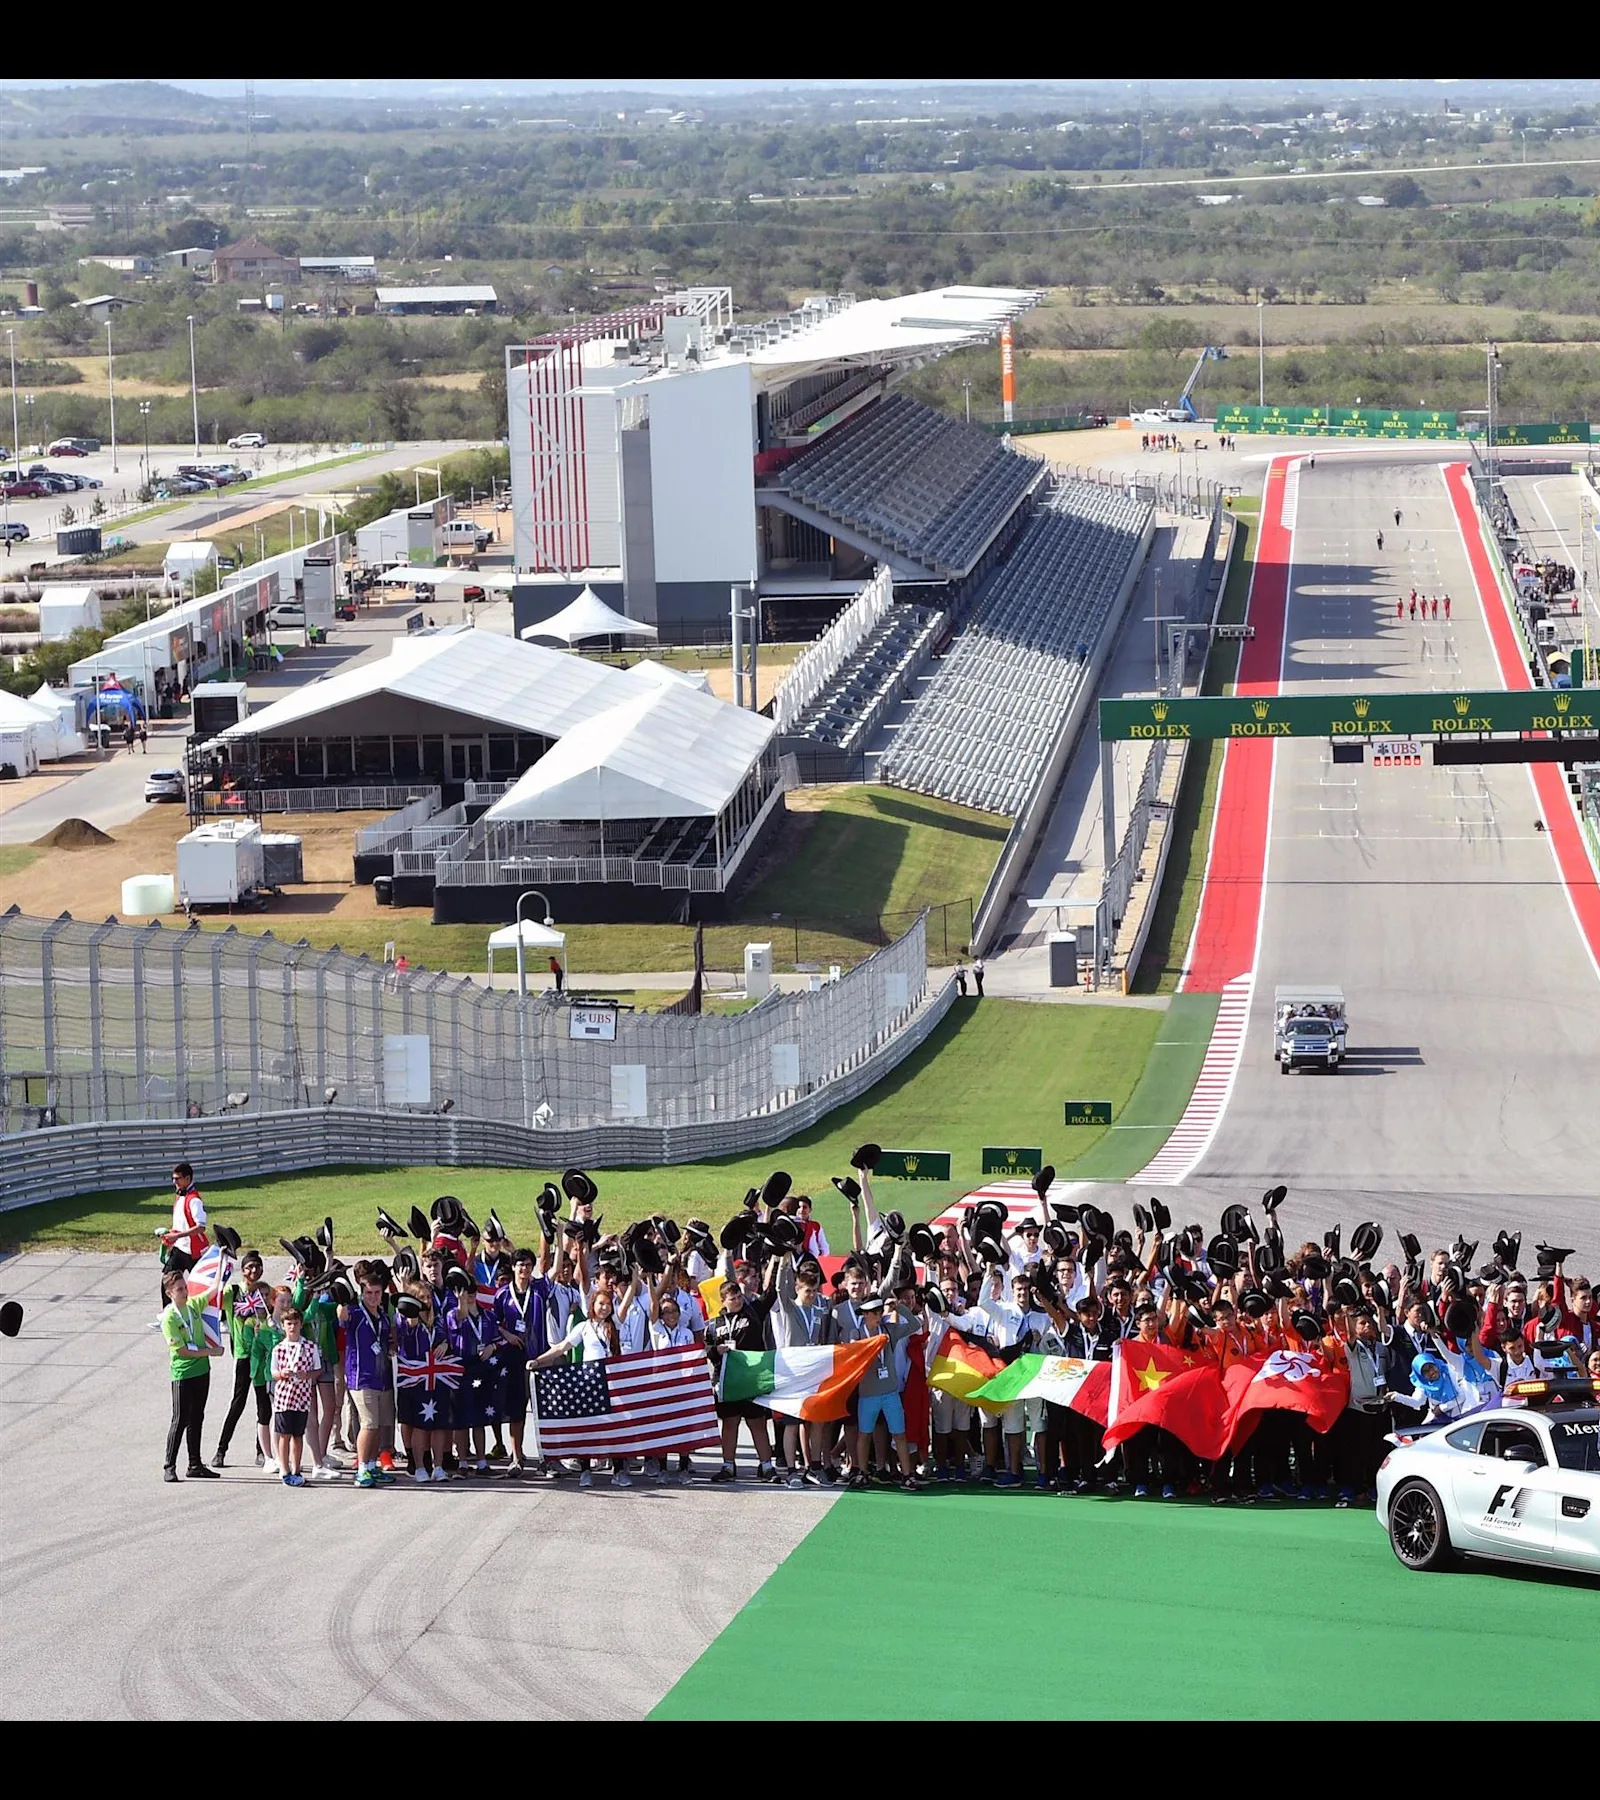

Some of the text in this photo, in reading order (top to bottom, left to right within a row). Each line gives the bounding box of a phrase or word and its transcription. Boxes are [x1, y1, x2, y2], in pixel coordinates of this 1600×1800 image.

[1342, 419, 1368, 427] ROLEX
[1383, 420, 1409, 429] ROLEX
[1423, 421, 1449, 429] ROLEX
[1548, 434, 1580, 443] ROLEX
[1331, 719, 1393, 734] ROLEX
[1431, 717, 1493, 731] ROLEX
[1531, 715, 1593, 729] ROLEX
[1129, 724, 1191, 738] ROLEX
[1230, 722, 1292, 736] ROLEX
[1391, 743, 1418, 754] UBS
[588, 1013, 612, 1024] UBS
[1071, 1116, 1105, 1124] ROLEX
[990, 1165, 1033, 1175] ROLEX
[1563, 1423, 1600, 1436] Mer
[1494, 1517, 1517, 1527] Formula
